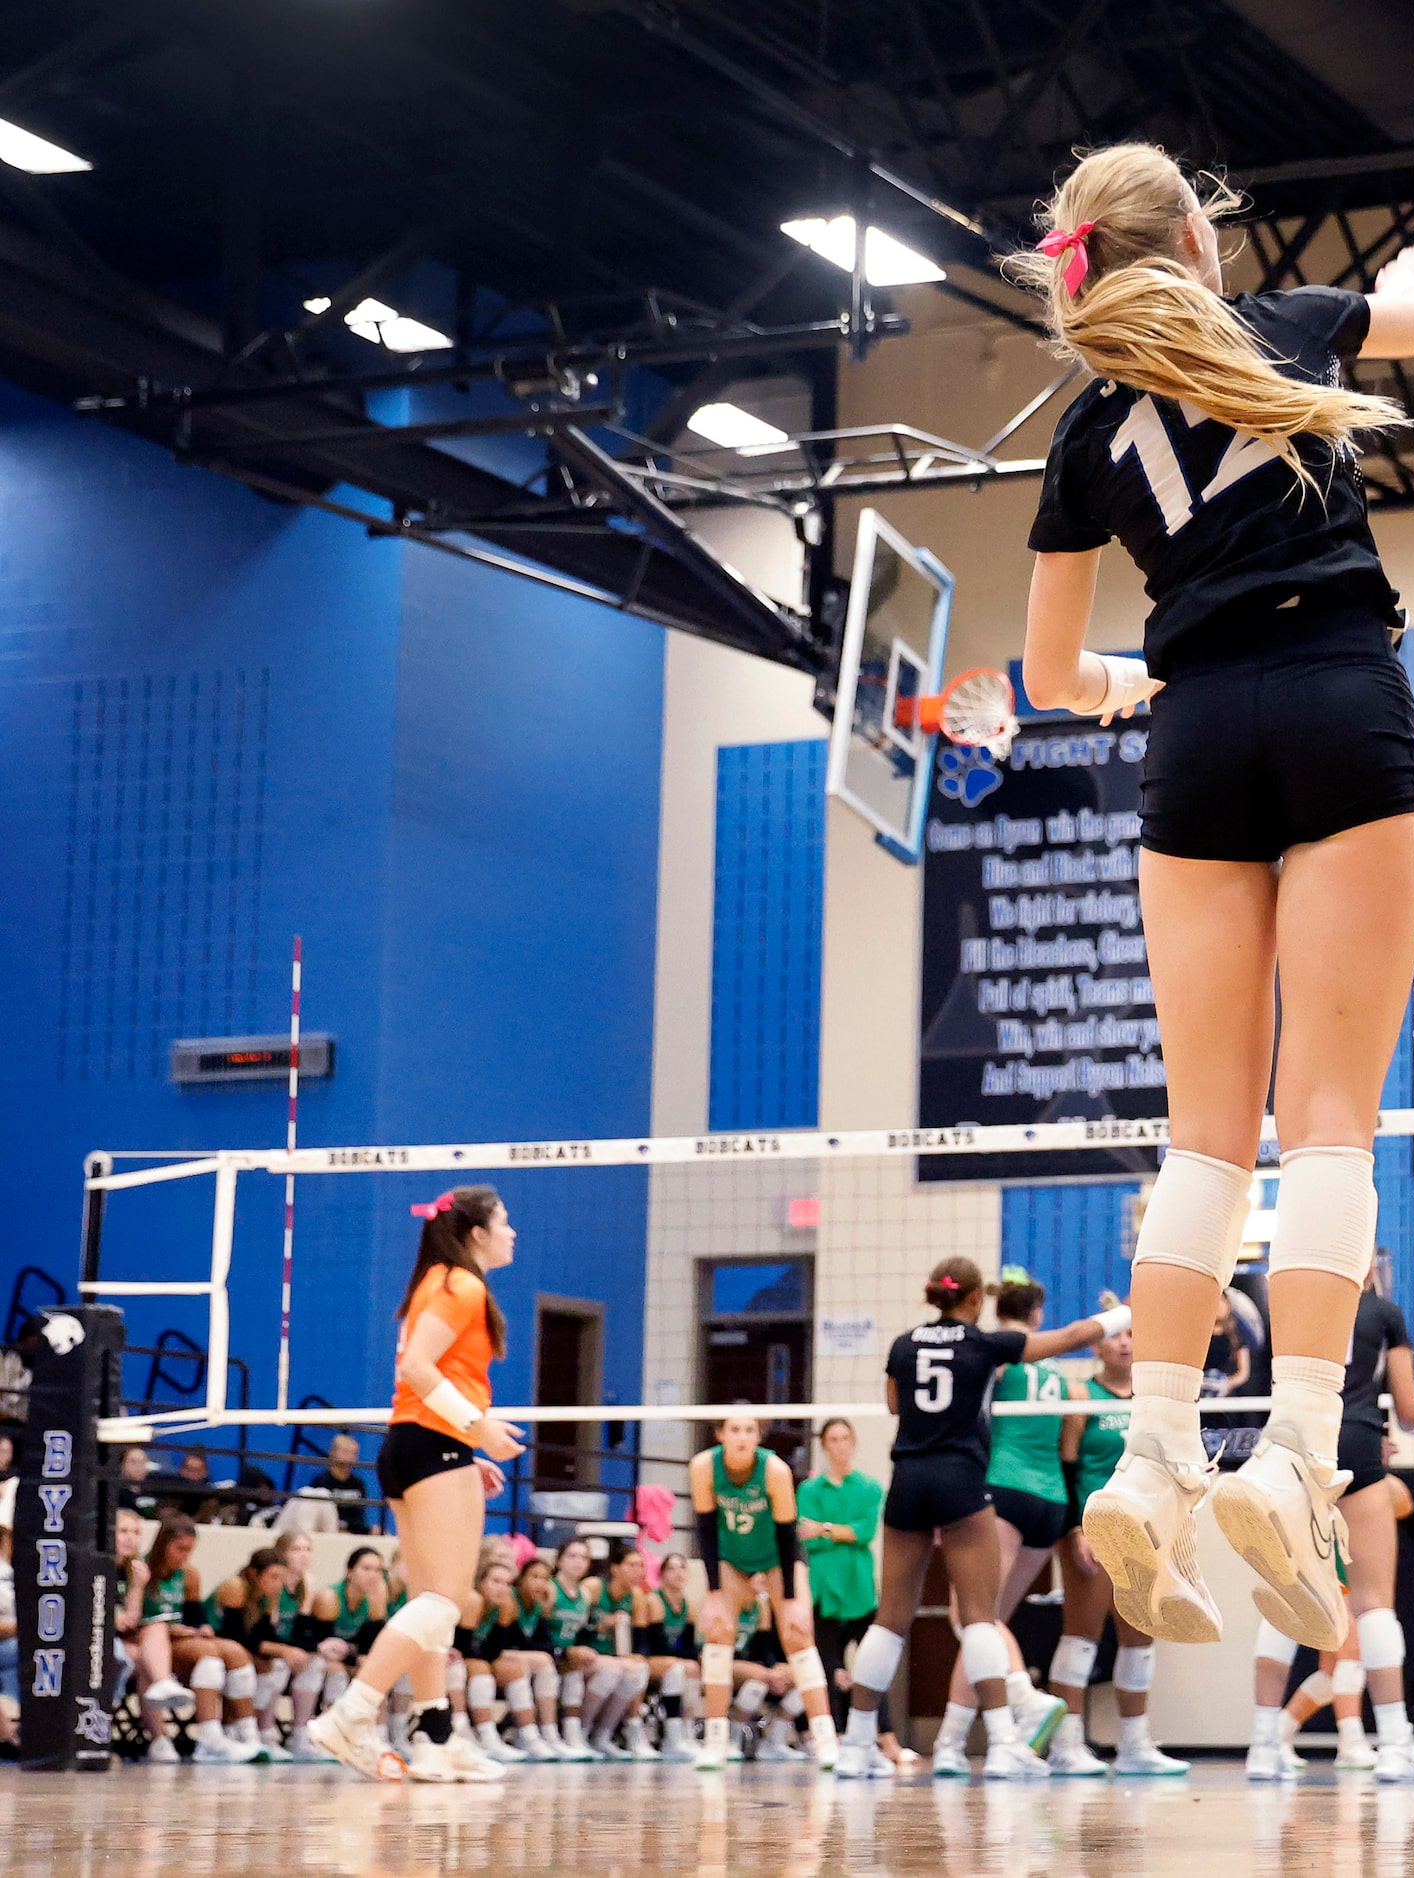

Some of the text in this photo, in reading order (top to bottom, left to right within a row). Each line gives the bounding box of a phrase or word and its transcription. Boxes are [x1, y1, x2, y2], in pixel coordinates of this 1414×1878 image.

[1010, 732, 1116, 771] FIGHT
[510, 1145, 593, 1160] BOBCATS
[696, 1138, 780, 1154] BOBCATS
[888, 1130, 976, 1148] BOBCATS
[328, 1150, 410, 1166] BOBCATS
[914, 1348, 955, 1413] 5
[1024, 1363, 1061, 1401] 14
[32, 1430, 73, 1697] BYRON
